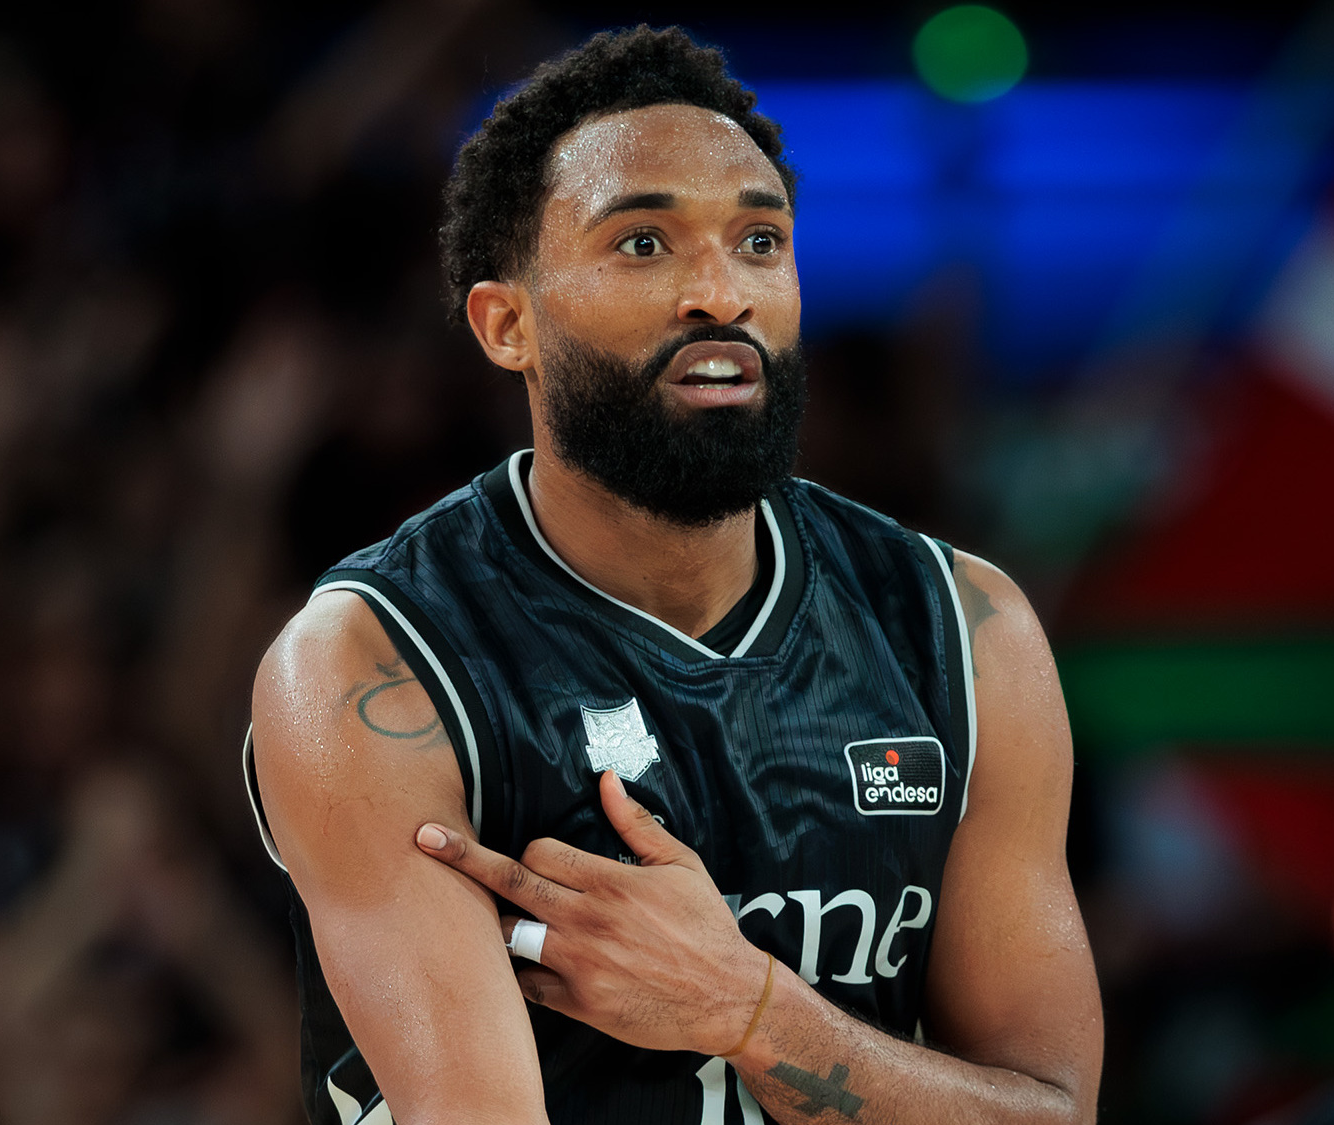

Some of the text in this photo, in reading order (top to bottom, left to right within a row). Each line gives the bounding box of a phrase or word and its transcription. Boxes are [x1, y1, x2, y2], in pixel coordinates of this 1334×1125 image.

[861, 762, 899, 785] liga
[865, 782, 938, 803] endesa
[721, 885, 932, 985] rne
